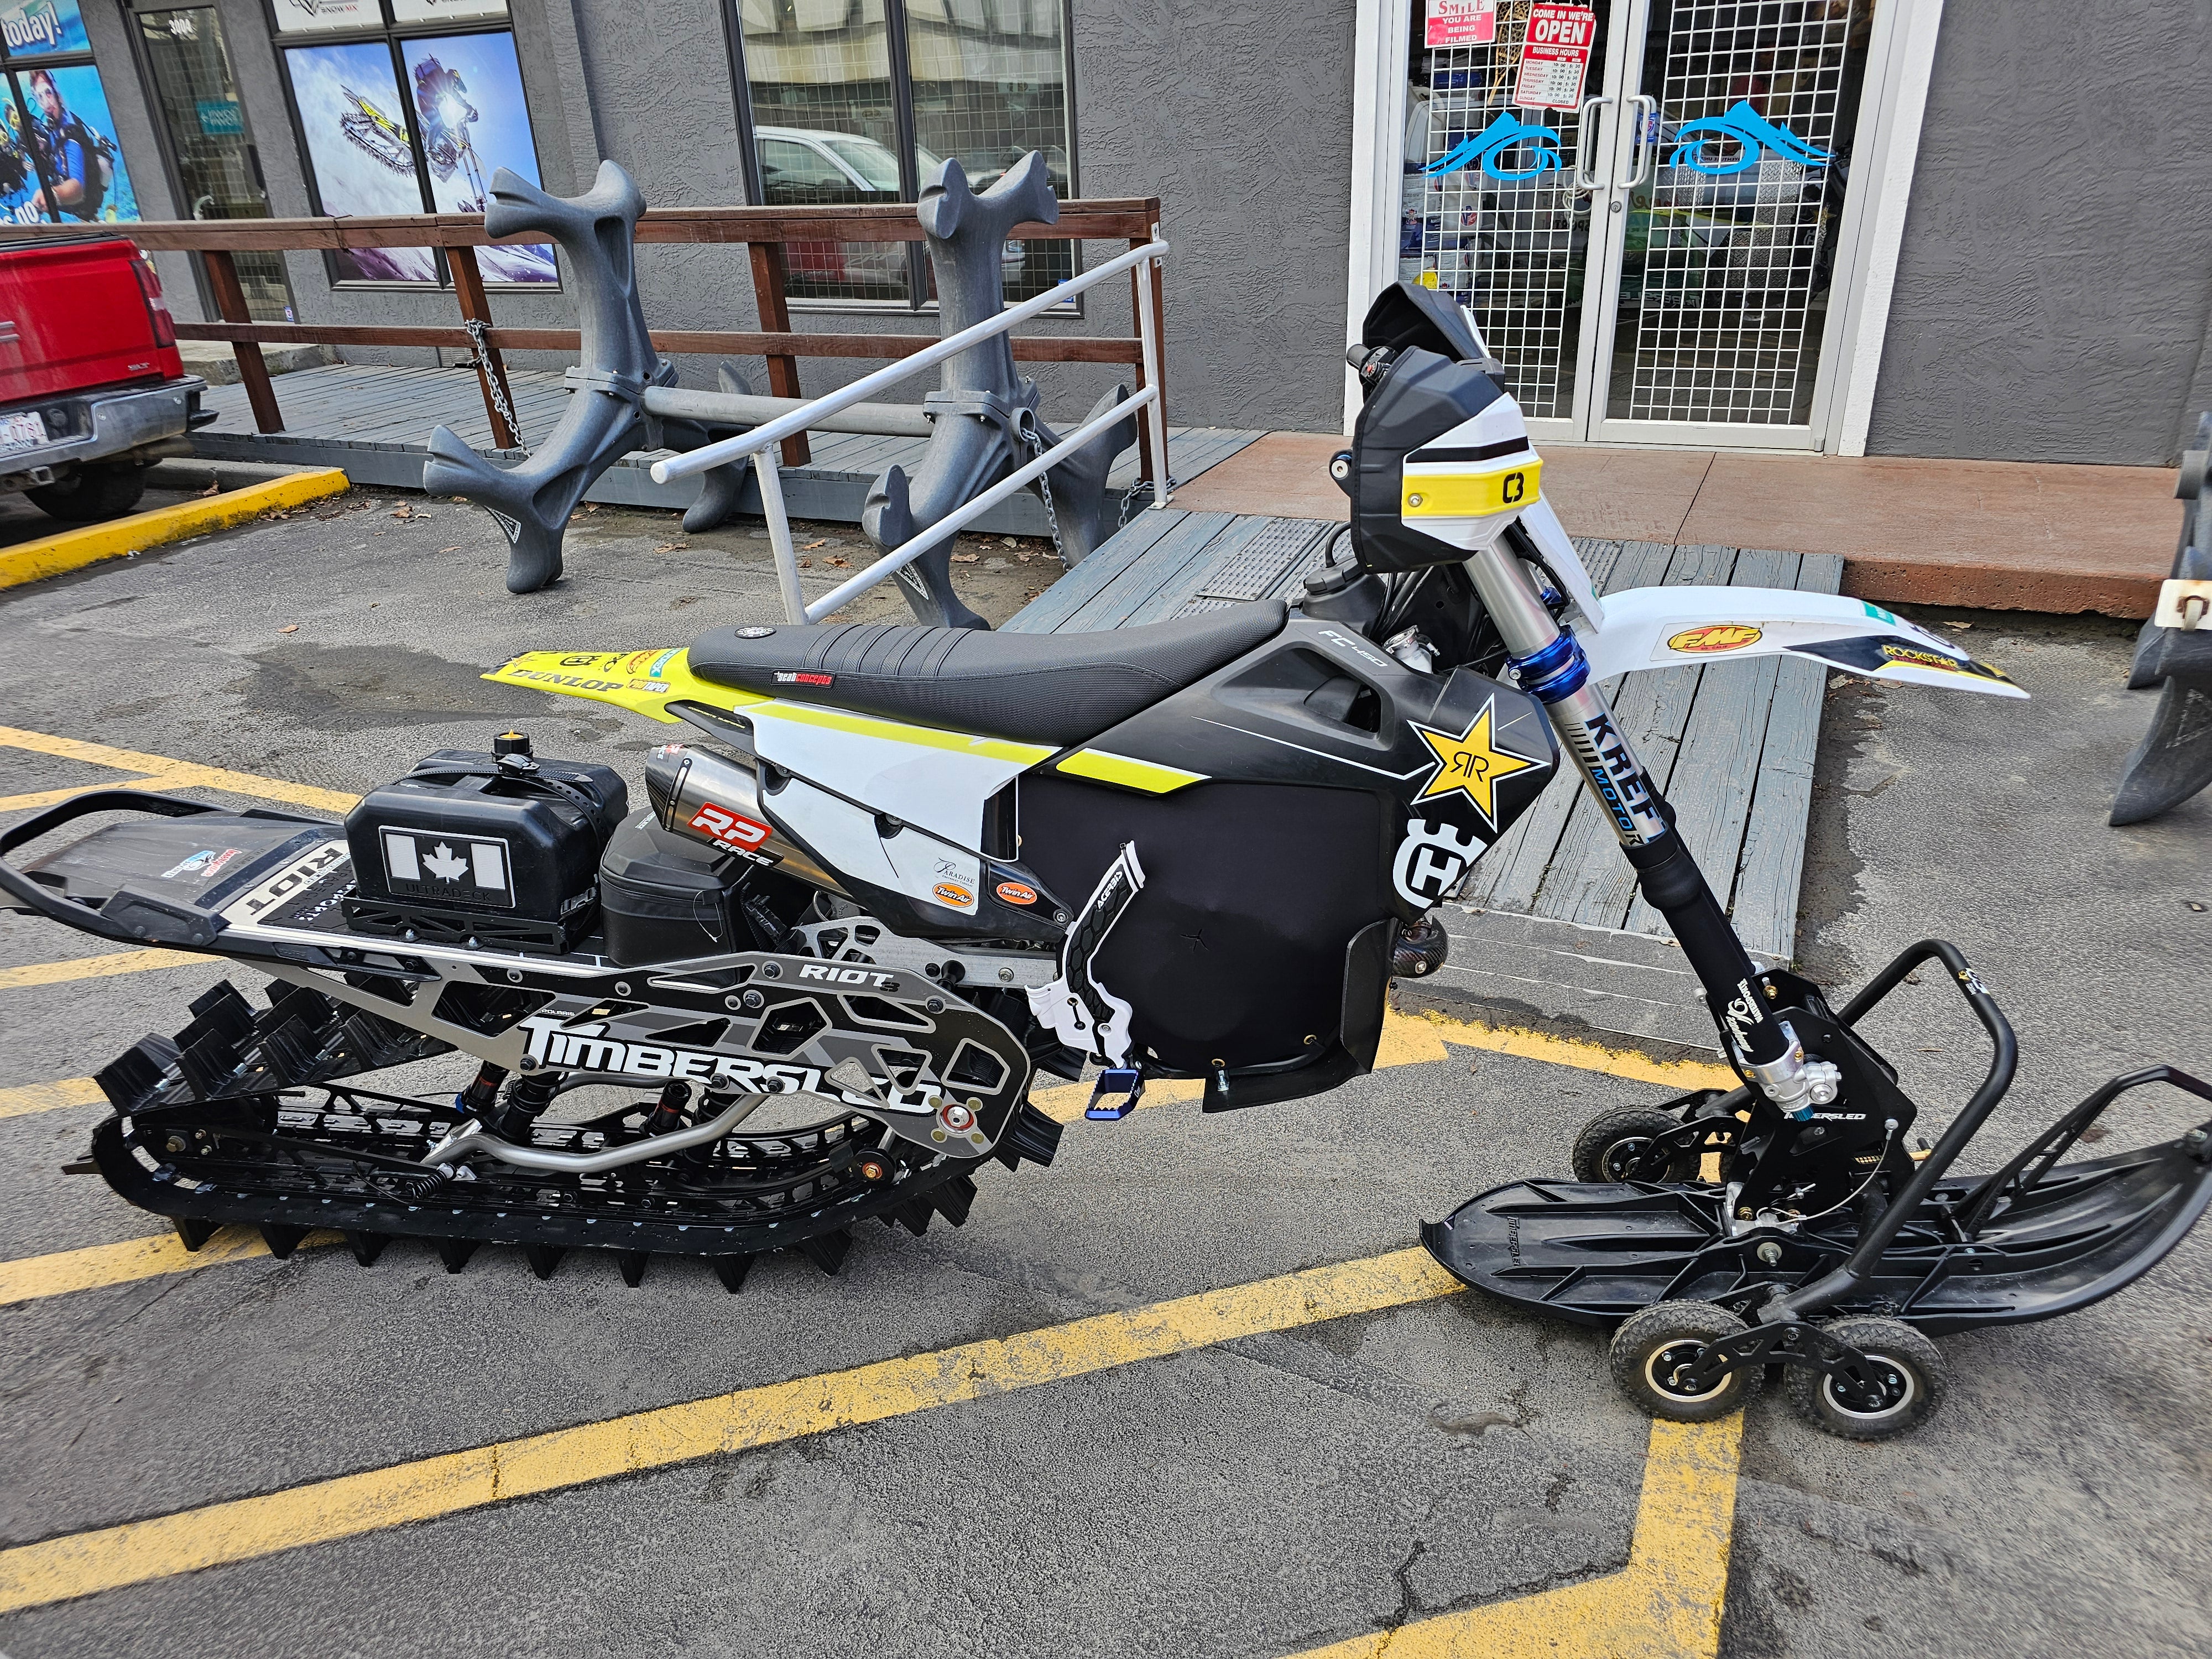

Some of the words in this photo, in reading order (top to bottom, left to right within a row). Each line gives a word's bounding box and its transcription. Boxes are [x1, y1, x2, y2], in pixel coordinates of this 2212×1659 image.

[1438, 0, 1484, 14] SMILE
[1532, 9, 1556, 19] COME
[1557, 10, 1566, 19] IN
[1568, 11, 1594, 22] WE'RE
[1, 1, 62, 48] today!
[1442, 16, 1461, 24] YOU
[1448, 25, 1475, 33] BEING
[1535, 19, 1586, 44] OPEN
[1445, 34, 1477, 44] FILMED
[1532, 46, 1559, 56] BUSINESS
[1318, 630, 1355, 647] FC
[1351, 646, 1388, 667] 450
[1670, 627, 1761, 650] FMF
[507, 669, 624, 692] DUNLOP
[1584, 712, 1665, 844] KREF
[1592, 768, 1632, 830] MOTO
[692, 808, 765, 843] RP
[712, 839, 774, 866] RACE
[246, 847, 343, 915] RIOT
[933, 857, 975, 884] PARADISE
[406, 883, 492, 902] ULTRADECK
[936, 886, 958, 900] Twin
[956, 894, 972, 904] Air
[999, 885, 1021, 897] Twin
[1020, 892, 1035, 901] Air
[799, 964, 894, 987] RIOT
[879, 982, 900, 993] 3
[541, 1009, 576, 1017] POLARIS
